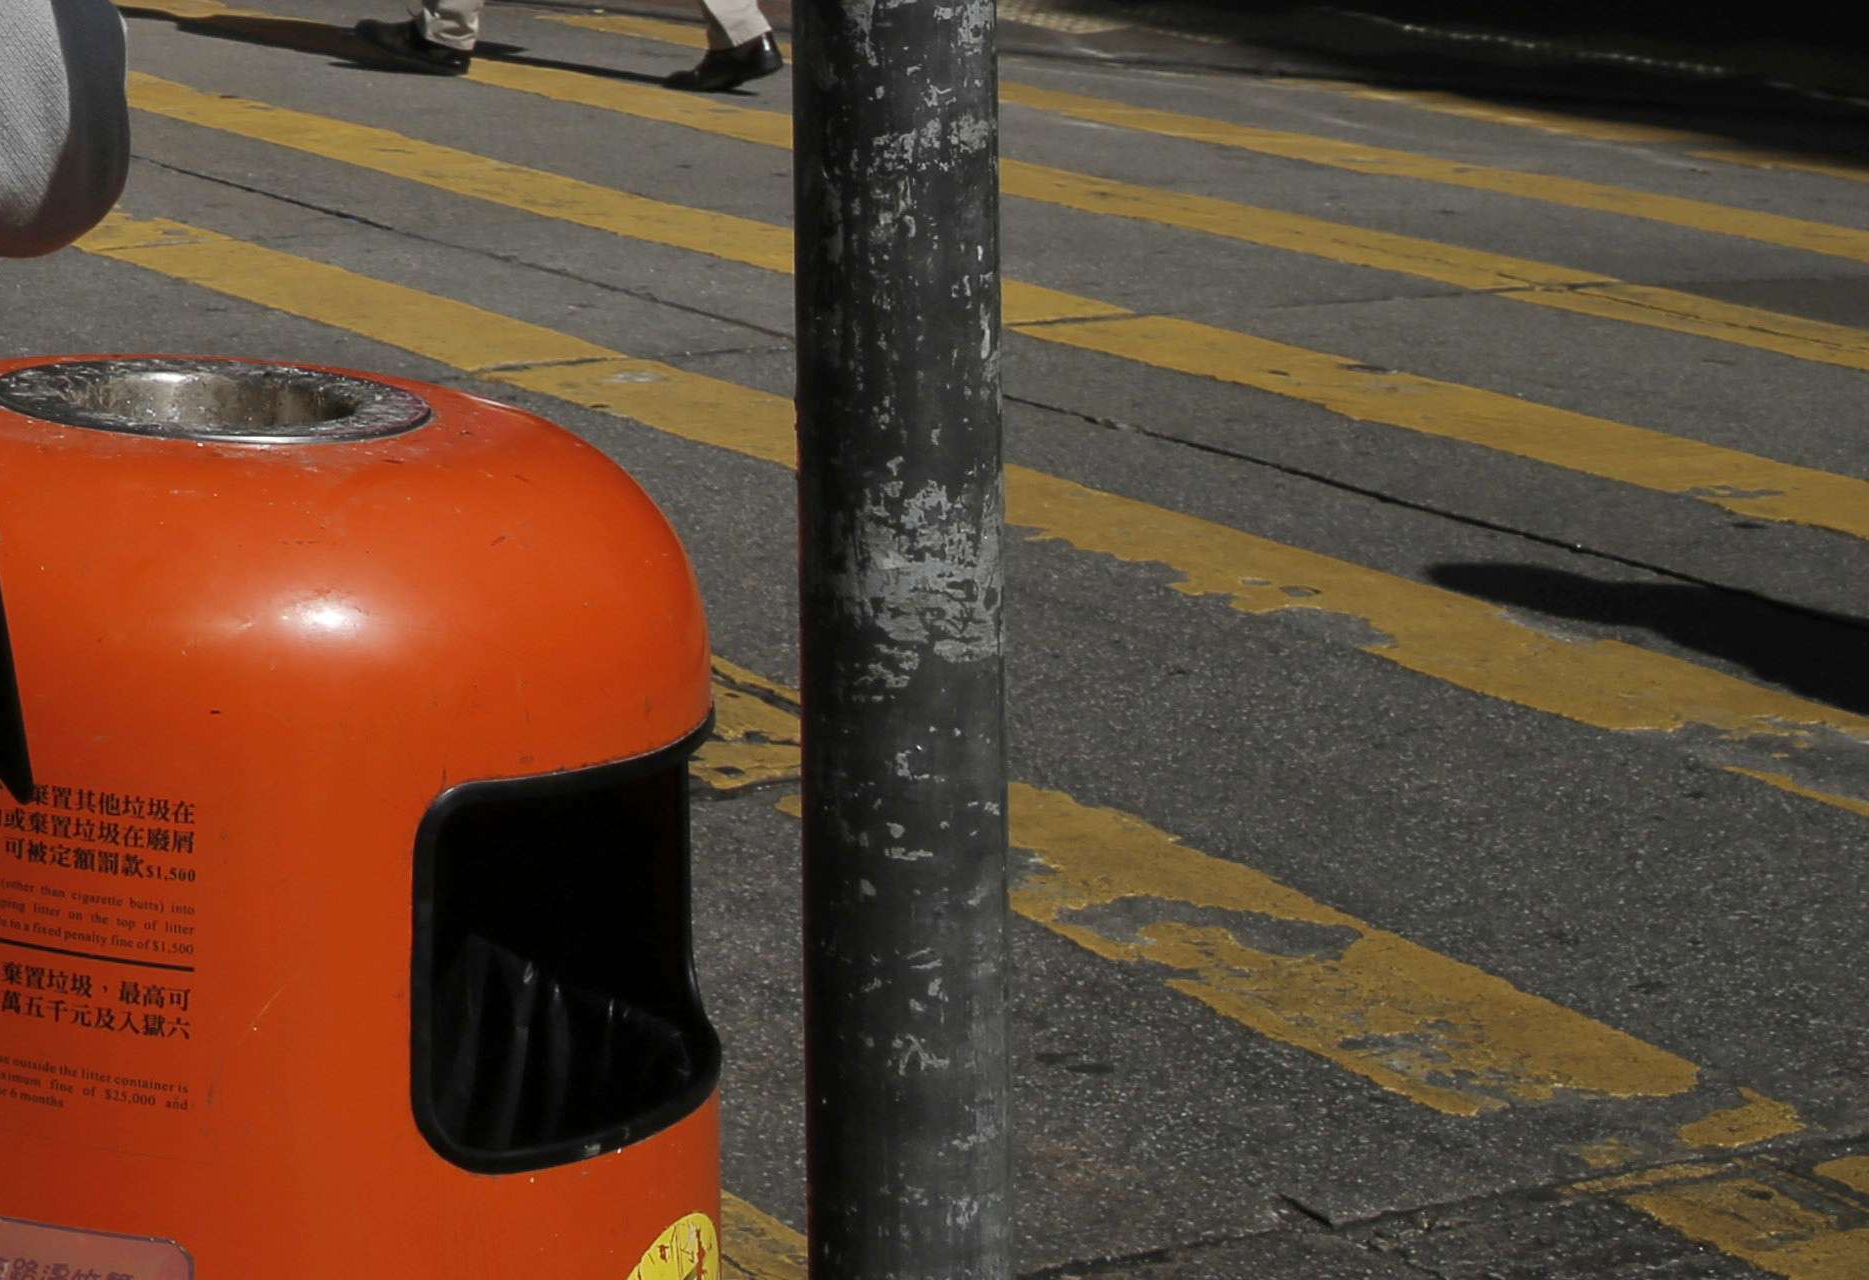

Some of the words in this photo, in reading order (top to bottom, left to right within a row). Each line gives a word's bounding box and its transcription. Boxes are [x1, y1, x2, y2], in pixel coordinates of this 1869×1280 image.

[41, 883, 65, 899] than
[72, 890, 122, 910] cigarette
[130, 897, 165, 914] butts)
[171, 903, 195, 916] into
[33, 901, 60, 917] litter
[68, 911, 83, 922] on
[90, 912, 110, 926] the
[116, 917, 136, 933] top
[144, 919, 158, 932] of
[165, 920, 195, 936] litter
[32, 920, 62, 938] fixed
[63, 926, 107, 946] penalty
[111, 933, 133, 948] fine
[136, 937, 150, 951] of
[152, 939, 195, 957] $1,500
[12, 1056, 56, 1074] outside
[59, 1063, 79, 1078] the
[81, 1067, 110, 1083] litter
[113, 1074, 175, 1094] container
[178, 1081, 188, 1094] is
[19, 1089, 65, 1110] months
[50, 1078, 74, 1095] fine
[82, 1085, 97, 1098] of
[104, 1087, 156, 1108] $25,000
[165, 1096, 188, 1111] and
